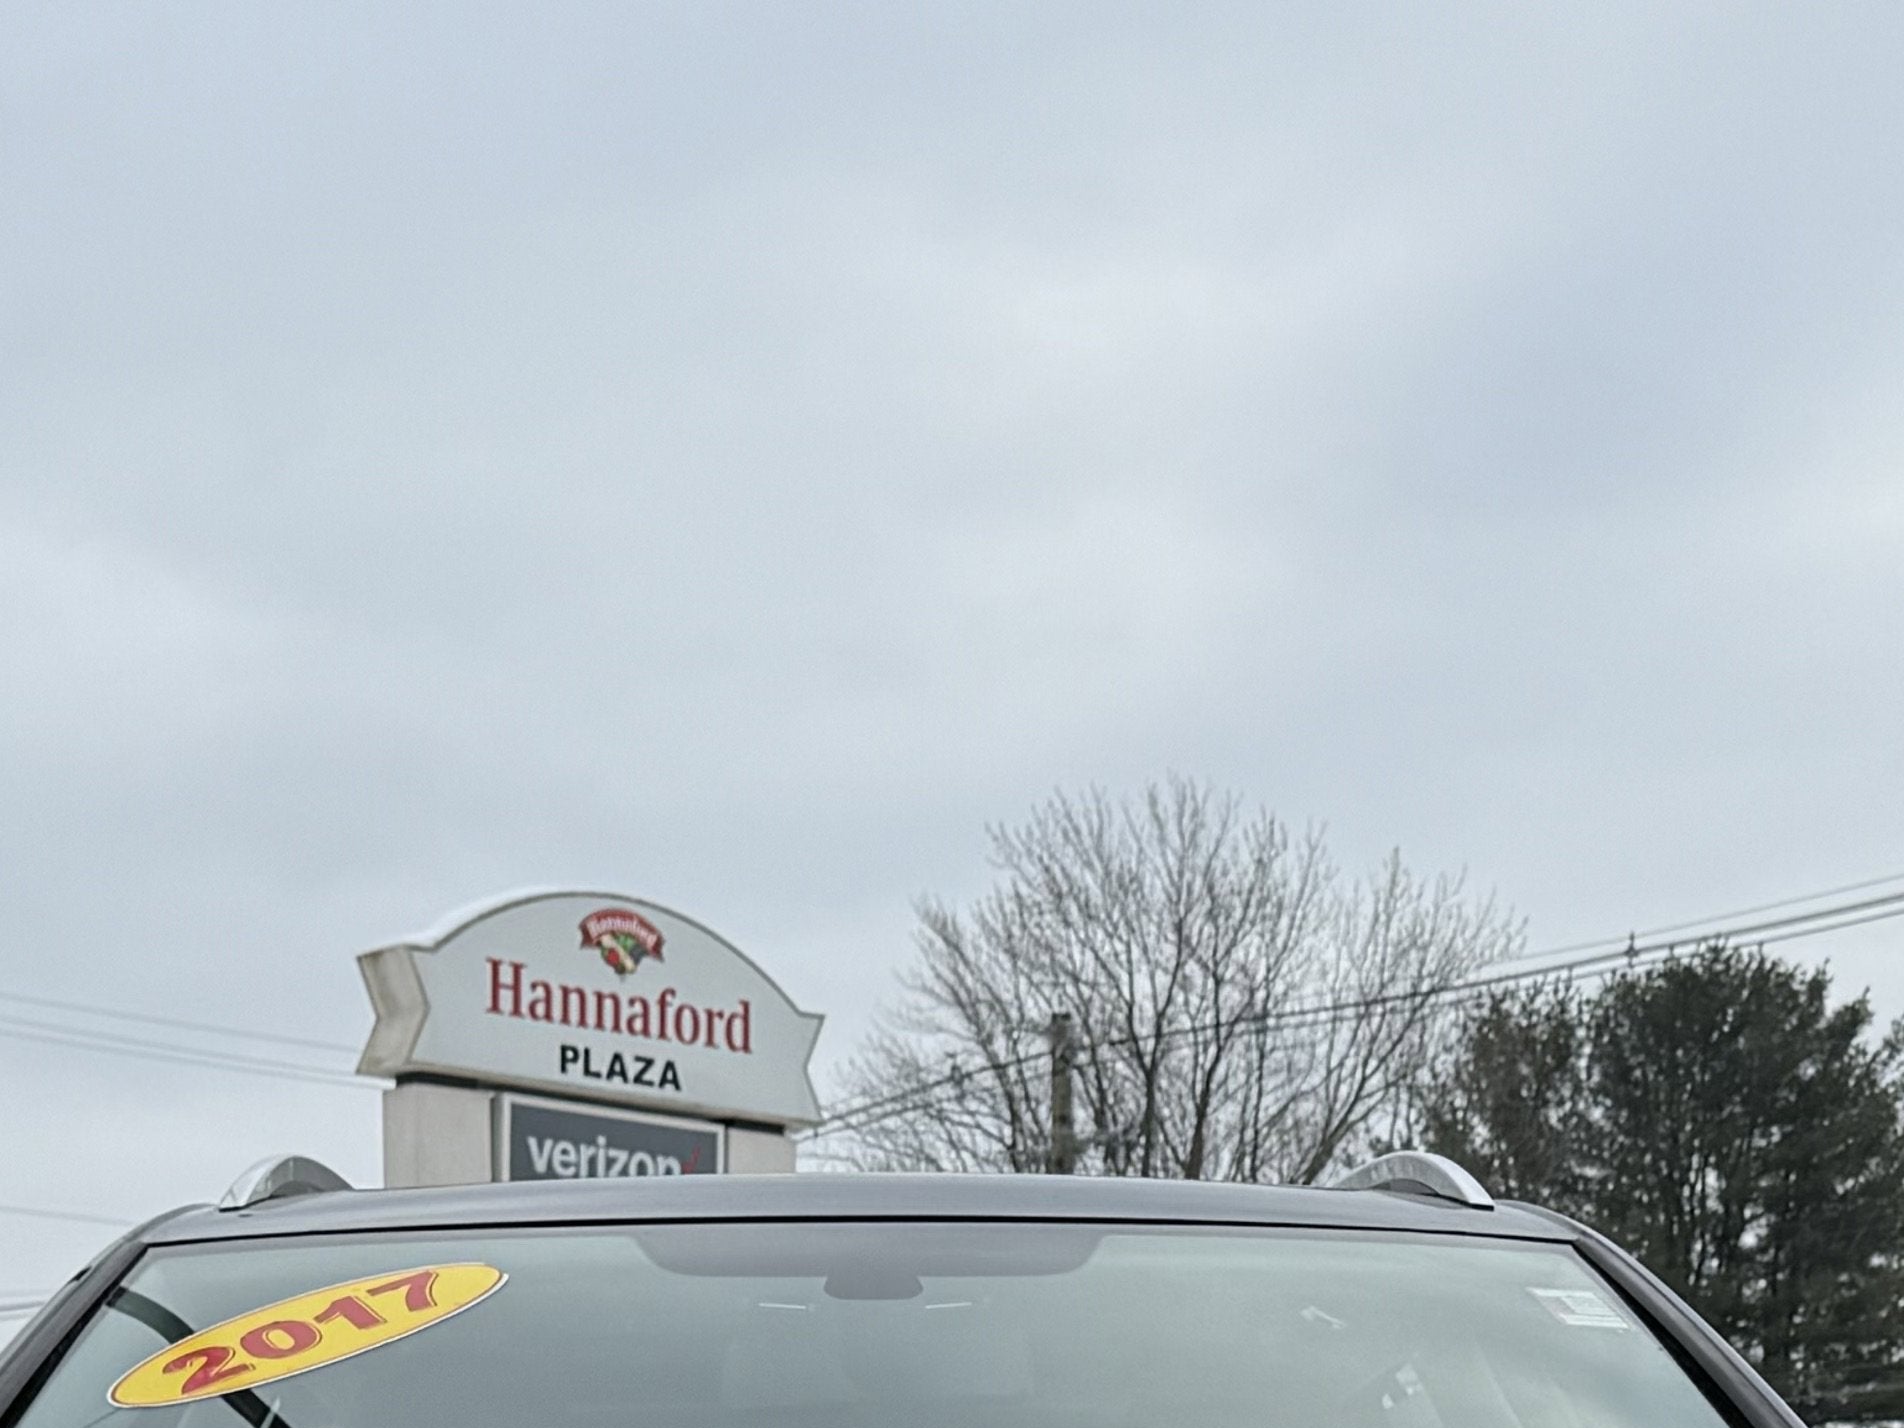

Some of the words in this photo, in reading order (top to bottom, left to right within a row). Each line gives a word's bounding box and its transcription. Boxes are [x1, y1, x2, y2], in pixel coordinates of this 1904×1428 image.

[485, 957, 752, 1054] Hannaford
[560, 1044, 682, 1091] PLAZA
[526, 1135, 682, 1178] verizon
[162, 1271, 440, 1396] 2017
